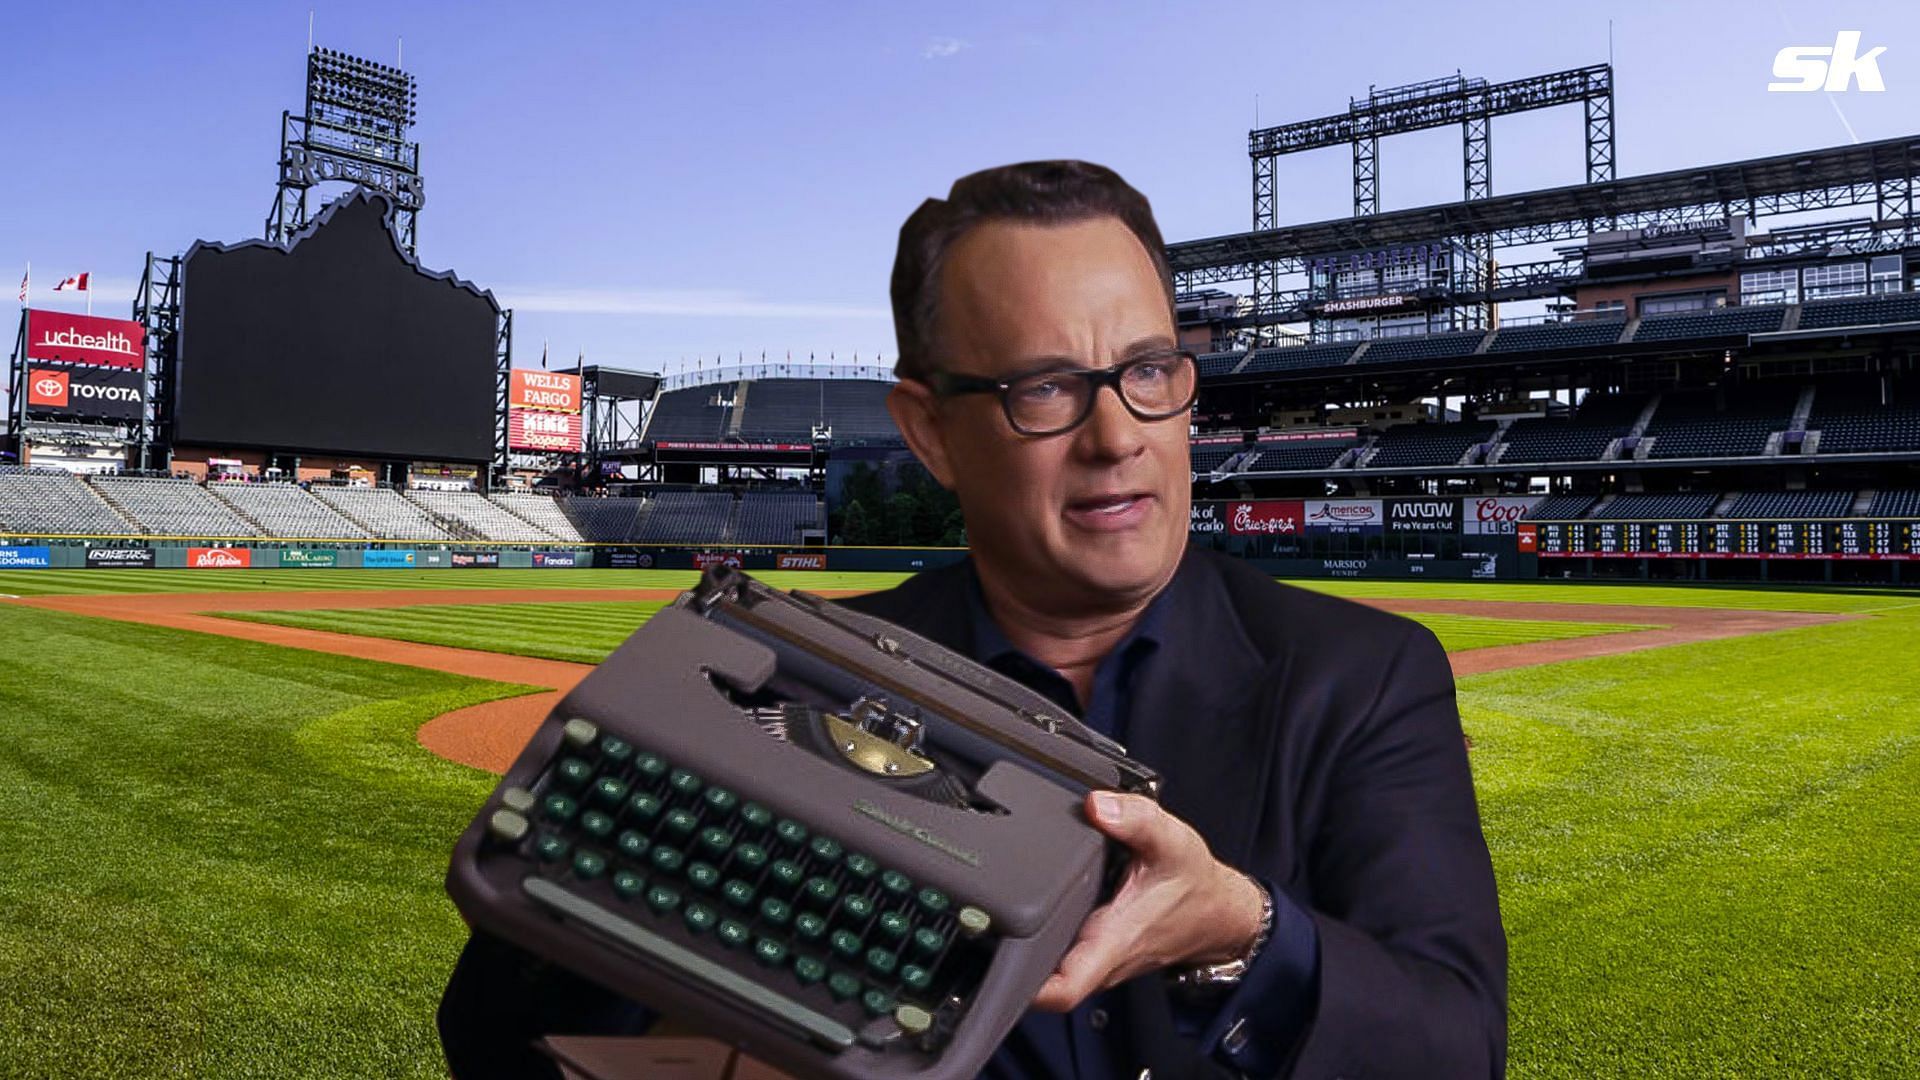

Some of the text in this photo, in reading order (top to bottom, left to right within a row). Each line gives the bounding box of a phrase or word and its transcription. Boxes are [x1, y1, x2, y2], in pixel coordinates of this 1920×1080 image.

[1324, 296, 1404, 313] SMASHBURGER
[45, 327, 131, 352] uchealth
[523, 373, 571, 390] WELLS
[70, 384, 141, 402] TOYOTA
[524, 390, 571, 406] FARGO
[1202, 505, 1214, 518] of
[1392, 503, 1453, 517] ARROW
[1476, 499, 1527, 522] Coor
[1487, 523, 1516, 533] LIGH
[544, 556, 574, 566] Fanatics
[781, 557, 821, 568] STIHL
[1324, 560, 1367, 569] MARSICO
